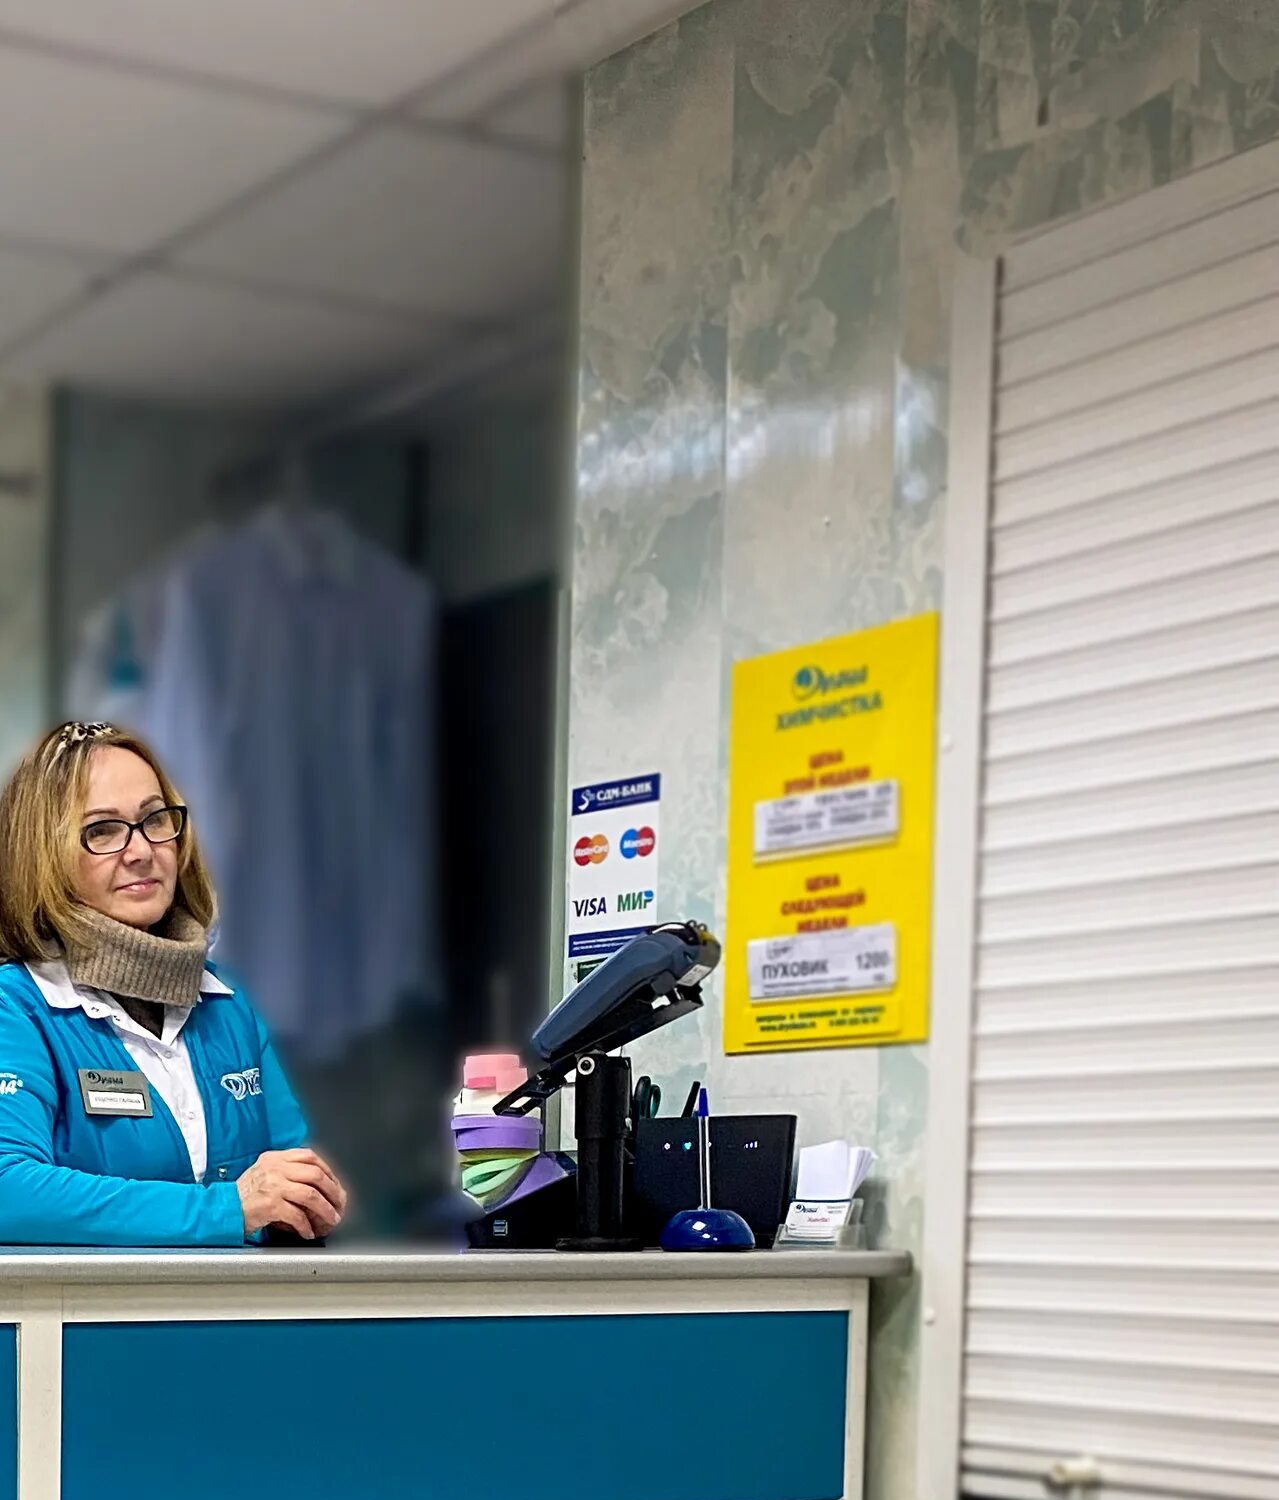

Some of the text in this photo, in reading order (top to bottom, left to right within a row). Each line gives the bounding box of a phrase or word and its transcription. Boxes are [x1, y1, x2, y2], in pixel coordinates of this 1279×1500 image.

[572, 897, 607, 917] VISA
[617, 890, 654, 912] МИР
[761, 958, 830, 981] ПУХОВИК
